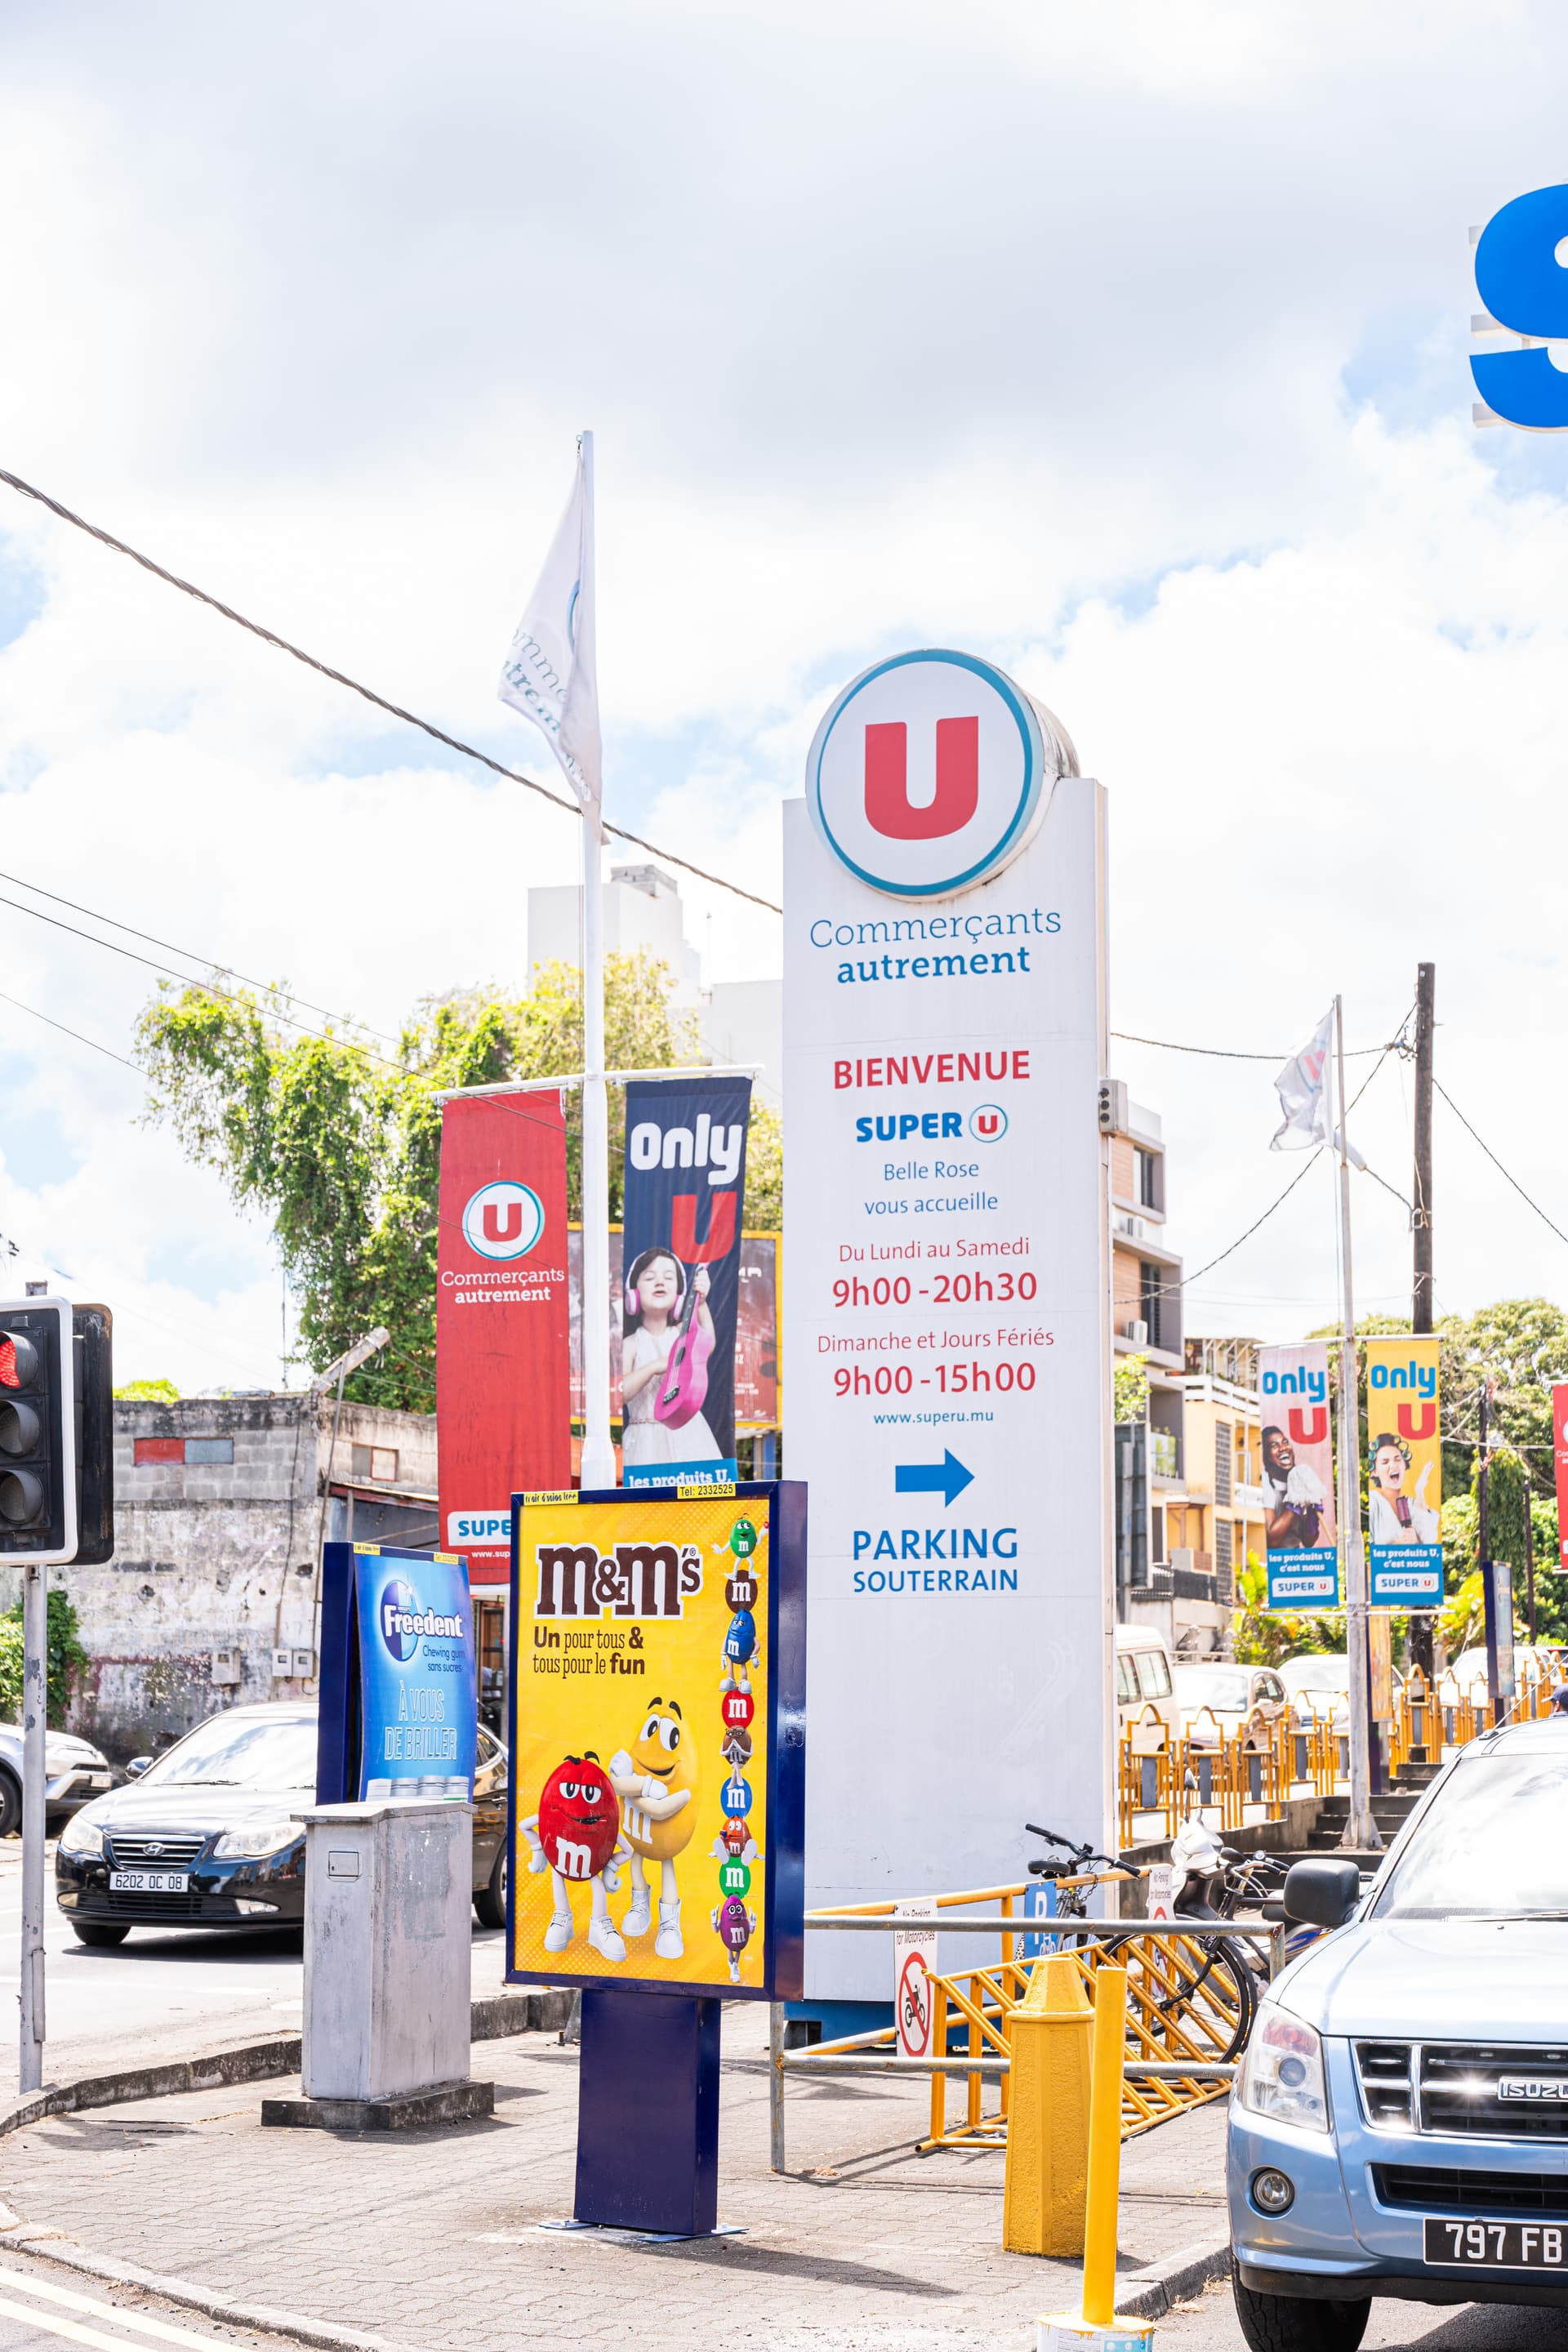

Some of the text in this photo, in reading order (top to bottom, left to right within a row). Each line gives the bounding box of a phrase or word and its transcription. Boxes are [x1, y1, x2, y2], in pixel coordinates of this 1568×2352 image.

[865, 715, 978, 840] U
[810, 906, 1062, 947] Commerçants
[837, 947, 1031, 983] autrement
[833, 1050, 1031, 1089] BIENVENUE
[856, 1112, 963, 1143] SUPER
[630, 1113, 743, 1185] Only
[884, 1161, 979, 1181] Belle Rose
[865, 1192, 998, 1215] vous accueille
[483, 1202, 522, 1242] U
[672, 1191, 738, 1264] U
[839, 1237, 1030, 1263] Du Lundi au Samedi
[441, 1267, 565, 1287] Commerçants
[454, 1286, 551, 1304] autrement
[817, 1328, 1054, 1353] Dimanche et Jours Fériés
[1263, 1365, 1325, 1402] Only
[1371, 1361, 1436, 1398] Only
[874, 1409, 994, 1426] www.superu.mu
[1288, 1407, 1327, 1445] U
[1397, 1403, 1436, 1440] U
[629, 1476, 649, 1487] les
[652, 1472, 712, 1486] produits
[680, 1485, 733, 1497] Tel: 2332525
[458, 1519, 511, 1536] SUPE
[853, 1527, 1018, 1561] PARKING
[1284, 1552, 1322, 1562] produits
[1373, 1549, 1386, 1557] les
[1388, 1548, 1428, 1558] produits
[1406, 1560, 1429, 1568] nous
[853, 1569, 1018, 1592] SOUTERRAIN
[1278, 1582, 1314, 1592] SUPER
[1381, 1579, 1419, 1588] SUPER
[384, 1605, 463, 1638] Freedent
[422, 1644, 449, 1660] Chewing
[534, 1626, 644, 1654] Un pour tous &
[427, 1662, 462, 1673] sans sucres
[532, 1651, 645, 1679] tous pour le fun
[399, 1679, 445, 1722] À VOUS
[384, 1726, 457, 1760] DE BRILLER
[116, 1874, 144, 1889] 6202
[168, 1875, 182, 1890] 08
[1446, 2223, 1562, 2263] 797 FB
